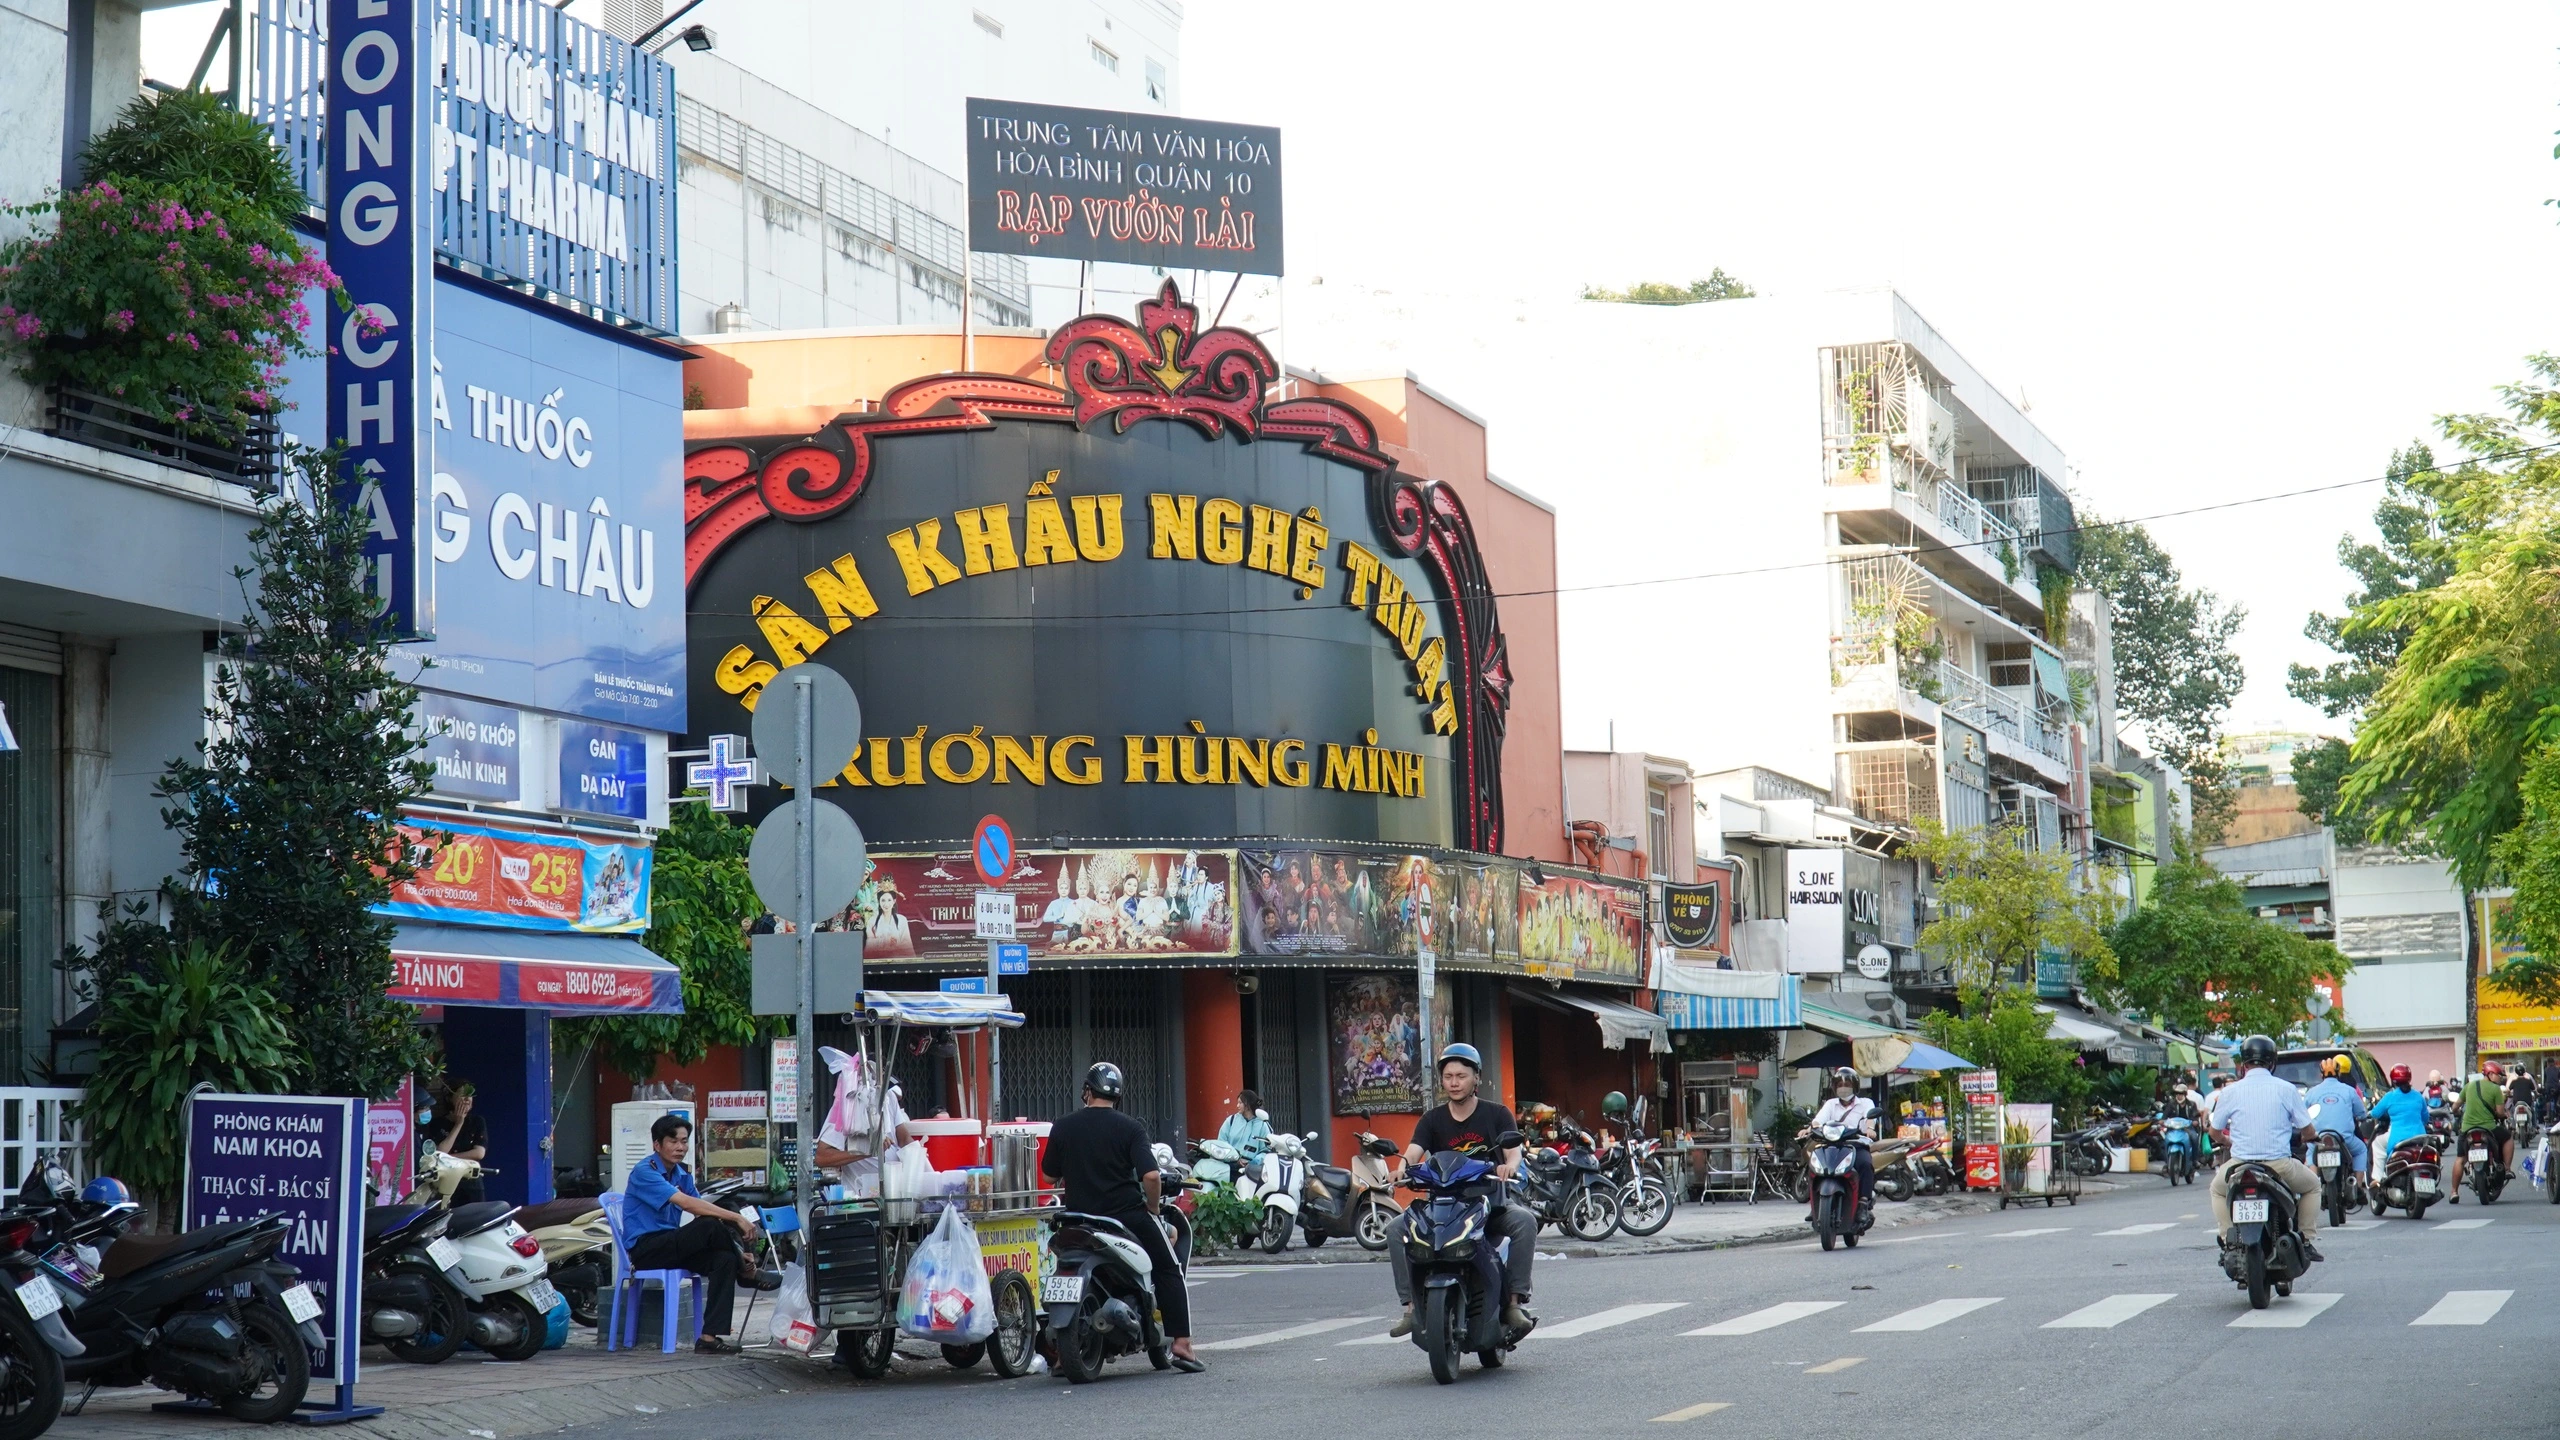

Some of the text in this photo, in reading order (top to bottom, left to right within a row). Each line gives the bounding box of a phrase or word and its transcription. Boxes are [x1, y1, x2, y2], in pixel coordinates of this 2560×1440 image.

[459, 32, 553, 136] DƯỢC
[563, 79, 657, 181] PHẨM
[977, 115, 1272, 166] TRUNG TÂM VĂN HÓA
[996, 147, 1252, 195] HÒA BÌNH QUẬN 10
[433, 122, 628, 263] PT PHARMA
[997, 188, 1255, 250] RẠP VƯỜN LÀI
[465, 387, 592, 469] THUỐC
[489, 496, 654, 609] CHÂU
[715, 469, 1459, 737] SÂN KHẤU NGHỆ THUẬT
[594, 671, 607, 685] BÁN
[615, 676, 636, 690] THUỐC
[636, 680, 656, 694] THÀNH
[656, 682, 674, 697] PHẨM
[594, 687, 605, 699] Giờ
[605, 689, 616, 701] Mở
[480, 715, 516, 748] KHỚP
[590, 738, 617, 761] GAN
[1124, 719, 1310, 788] HÙNG
[435, 748, 507, 786] THẦN KINH
[580, 772, 626, 800] DẠ DÀY
[530, 852, 577, 896] 25%
[1672, 904, 1687, 918] VÉ
[1673, 891, 1710, 906] PHÒNG
[1790, 891, 1843, 905] HAIR SALON
[929, 906, 960, 921] TRUY
[402, 957, 434, 994] TẬN
[436, 963, 464, 989] NƠI
[566, 971, 590, 995] 1800
[591, 972, 616, 996] 6928
[950, 981, 976, 991] ĐƯỜNG
[213, 1112, 323, 1133] PHÒNG KHÁM
[378, 1126, 398, 1135] 99.7%
[213, 1136, 323, 1159] NAM KHOA
[201, 1175, 247, 1199] THẠC
[250, 1174, 266, 1196] SĨ
[278, 1175, 312, 1199] BÁC
[315, 1176, 331, 1200] SĨ
[2238, 1211, 2263, 1221] 3629
[278, 1210, 329, 1256] TÂN
[983, 1246, 1032, 1277] MINH ĐỨC
[1045, 1289, 1079, 1302] 353.84
[1050, 1277, 1079, 1288] 59-C2
